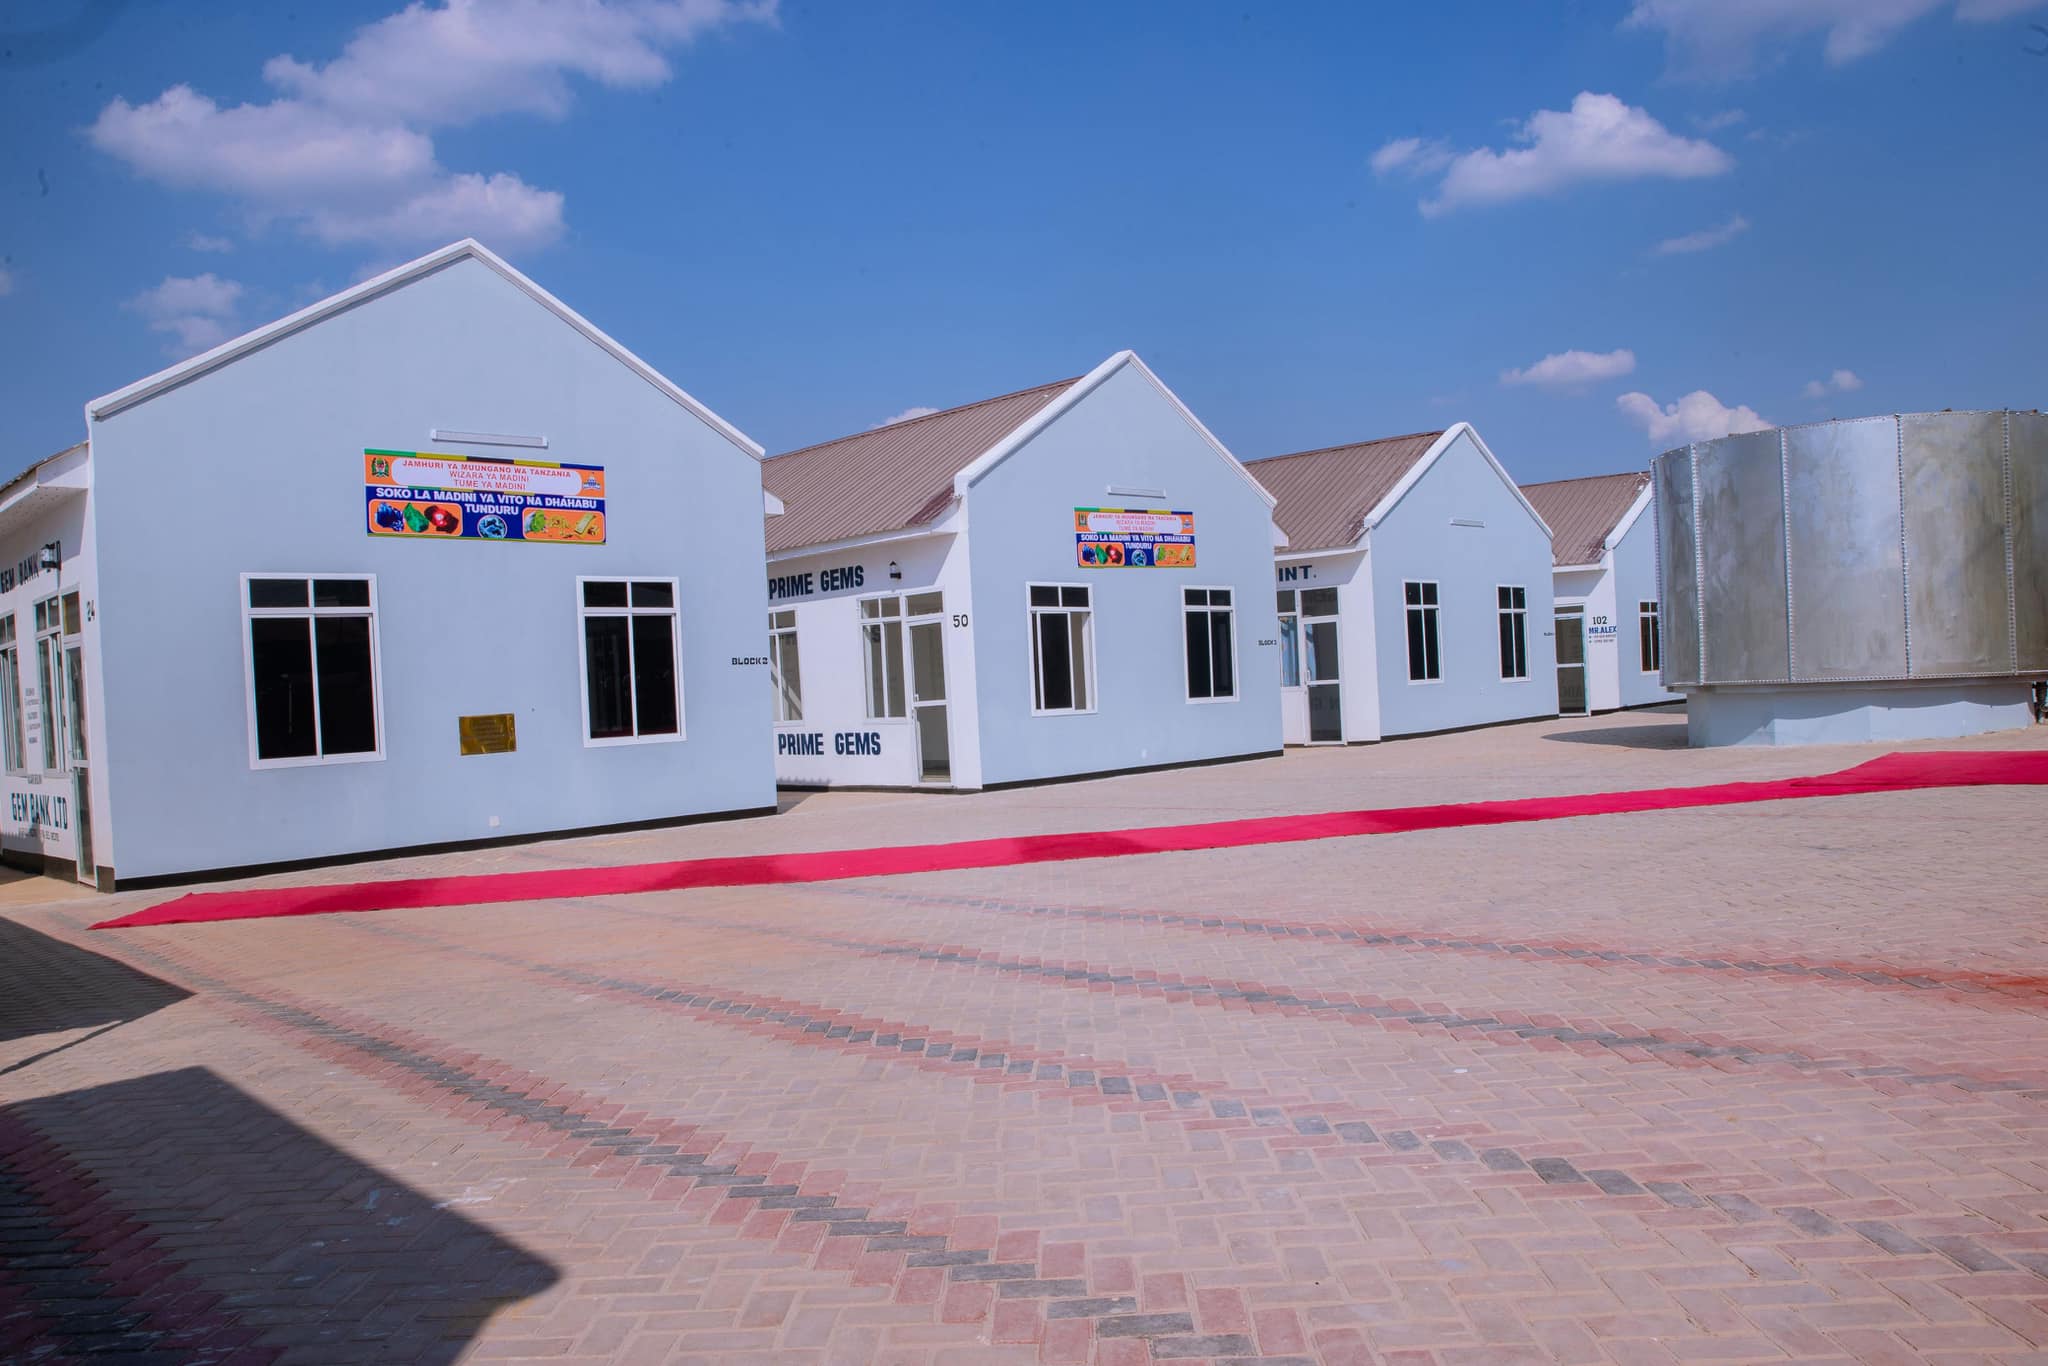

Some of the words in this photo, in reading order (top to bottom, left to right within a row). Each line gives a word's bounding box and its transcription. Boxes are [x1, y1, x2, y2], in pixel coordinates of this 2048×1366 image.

[402, 460, 443, 469] JAMHURI
[461, 464, 511, 474] MUUNGANO
[529, 468, 571, 478] TANZANIA
[450, 470, 482, 480] WIZARA
[497, 474, 529, 482] MADINI
[454, 479, 478, 488] TUME
[481, 481, 493, 489] YA
[495, 482, 526, 490] MADINI
[376, 487, 411, 499] SOKO
[414, 490, 431, 500] LA
[433, 491, 477, 503] MADINI
[479, 493, 495, 503] YA
[496, 494, 523, 505] VITO
[526, 495, 543, 506] NA
[545, 497, 597, 509] DHAHABU
[465, 504, 519, 515] TUNDURU
[1278, 565, 1316, 582] INT.
[768, 573, 814, 600] PRIME
[820, 565, 864, 592] GEMS
[952, 614, 969, 628] 50
[1592, 616, 1608, 625] 102
[731, 657, 761, 665] BLOCK
[777, 733, 824, 756] PRIME
[834, 732, 881, 756] GEMS
[11, 792, 29, 822] GEM
[30, 793, 51, 826] BANK
[53, 796, 68, 830] LTD
